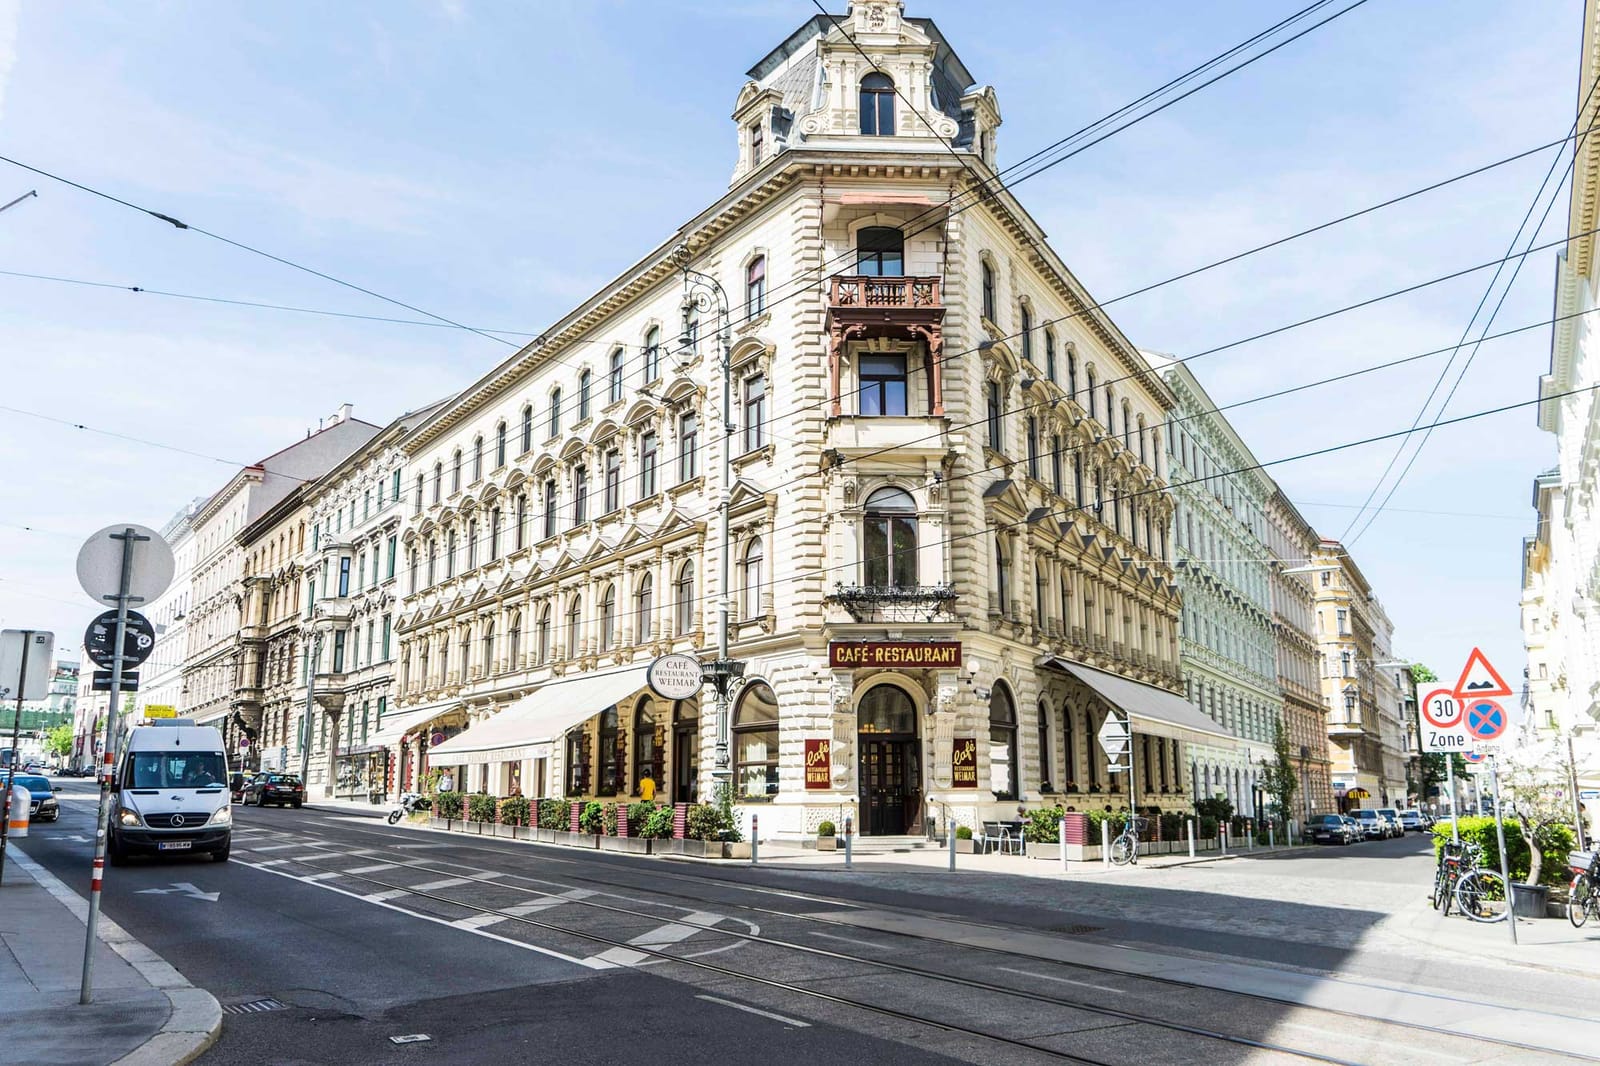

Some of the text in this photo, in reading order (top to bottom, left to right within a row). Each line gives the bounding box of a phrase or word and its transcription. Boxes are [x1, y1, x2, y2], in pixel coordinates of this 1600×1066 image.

[655, 669, 699, 678] RESTAURANT
[658, 677, 695, 687] WEIMAR
[1434, 699, 1453, 717] 30
[1429, 731, 1464, 747] Zone
[807, 772, 829, 782] WEIMAR
[954, 771, 976, 781] WEIMAR
